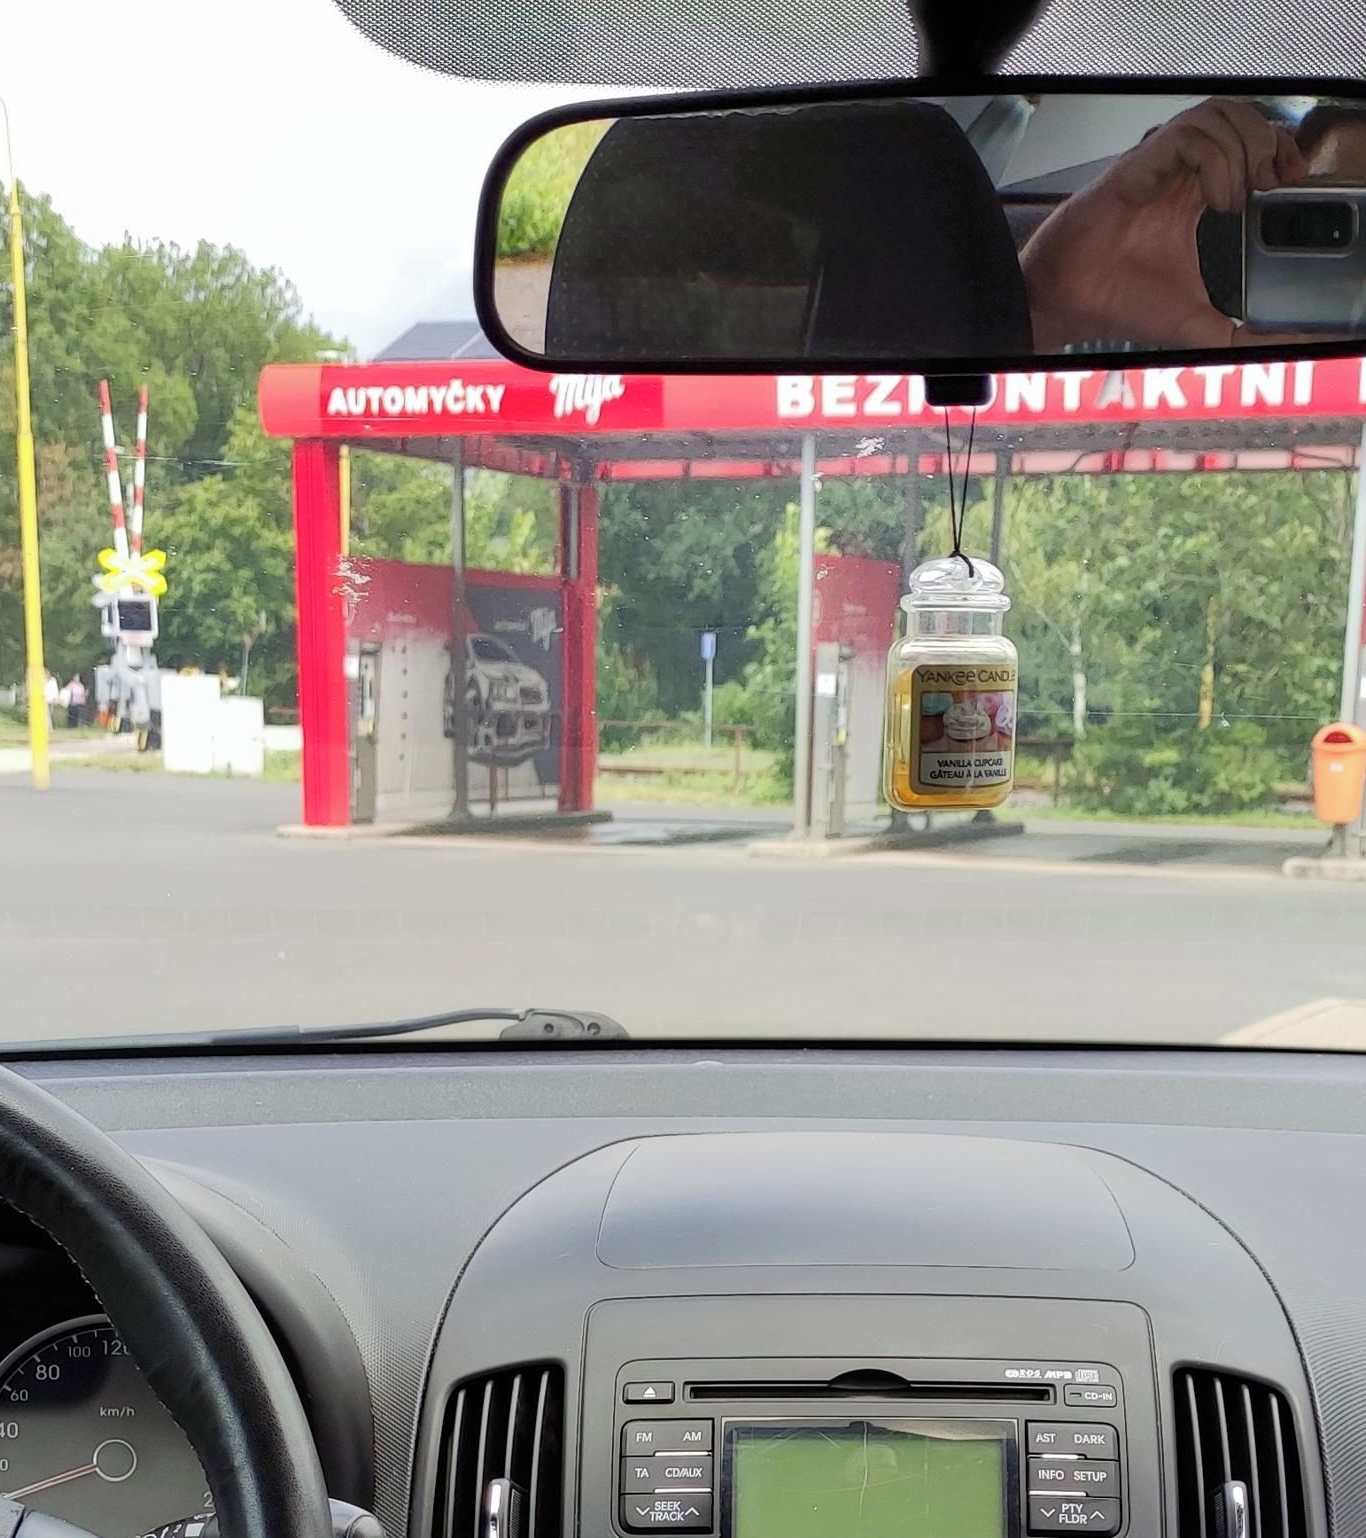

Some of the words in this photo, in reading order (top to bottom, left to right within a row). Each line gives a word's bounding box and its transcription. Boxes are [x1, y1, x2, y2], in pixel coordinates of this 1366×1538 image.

[327, 378, 505, 415] AUTOMYČKY
[937, 757, 973, 768] VANILLA
[68, 1346, 91, 1358] 100
[35, 1364, 60, 1381] 80
[10, 1389, 29, 1402] 60
[1084, 1391, 1113, 1401] CD-IN
[99, 1406, 135, 1418] km/h
[636, 1432, 652, 1443] FM
[683, 1431, 702, 1442] AM
[1035, 1433, 1056, 1443] AST
[1074, 1434, 1106, 1444] DARK
[635, 1468, 649, 1478] TA
[665, 1467, 703, 1478] CD/AUX
[1038, 1470, 1065, 1480] INFO
[1073, 1471, 1107, 1482] SETUP
[654, 1501, 681, 1511] SEEK
[1062, 1503, 1083, 1514] PTY
[649, 1511, 685, 1522] TRACK
[1058, 1513, 1087, 1525] FLDR
